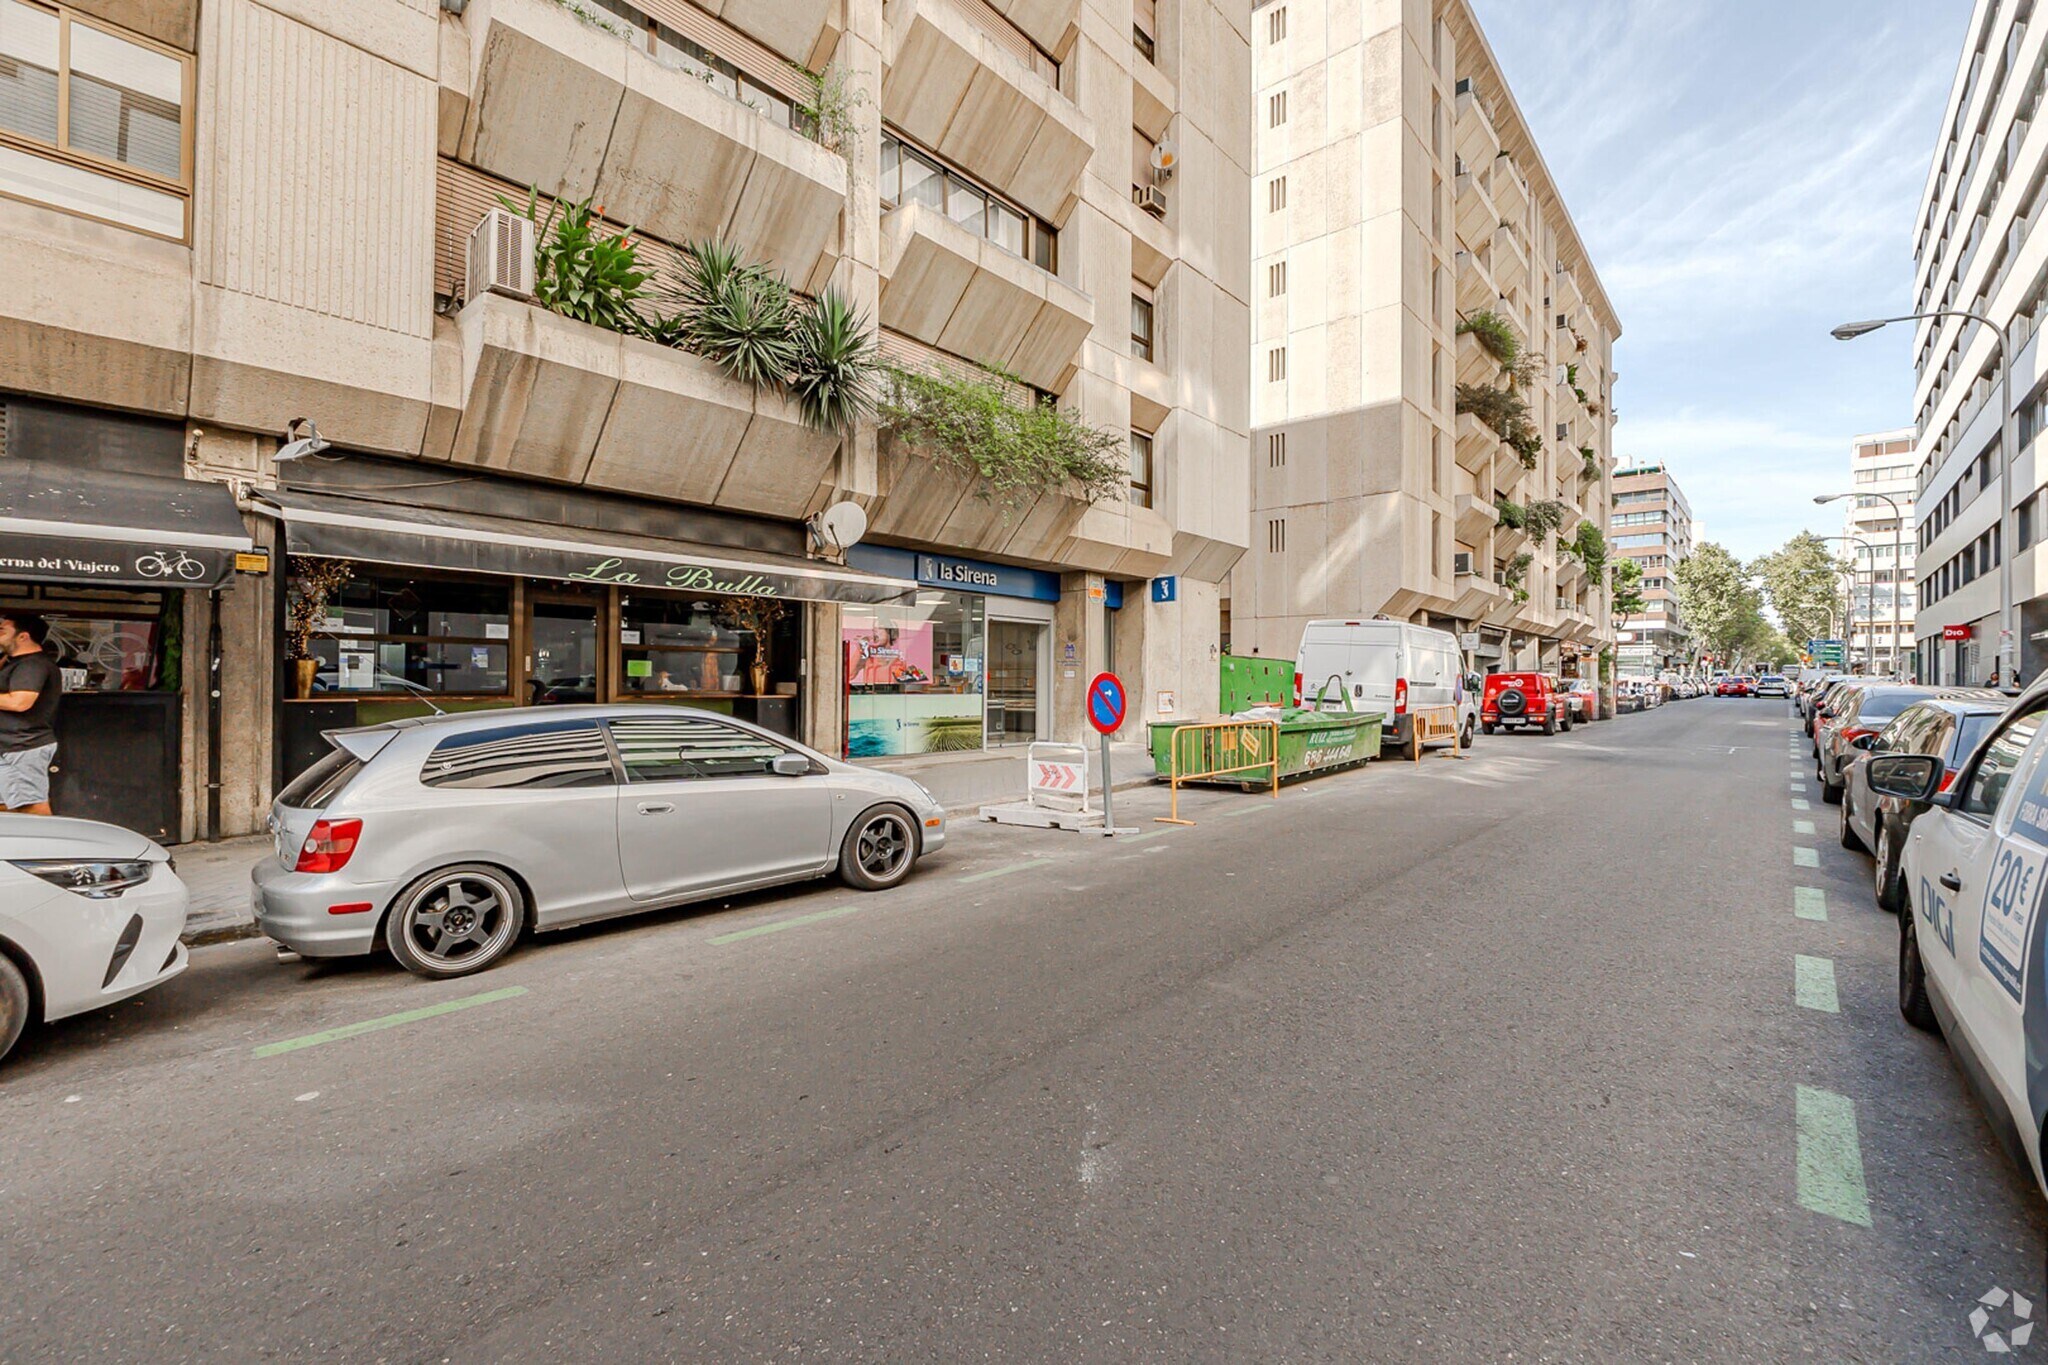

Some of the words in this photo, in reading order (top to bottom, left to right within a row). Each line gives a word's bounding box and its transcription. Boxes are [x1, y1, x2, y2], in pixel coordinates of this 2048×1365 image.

[37, 557, 61, 570] del
[64, 559, 120, 574] Viajero
[568, 557, 640, 584] La
[665, 565, 778, 596] Bulla
[940, 562, 953, 580] la
[955, 564, 997, 586] Sirena
[1921, 875, 1957, 960] DIGI
